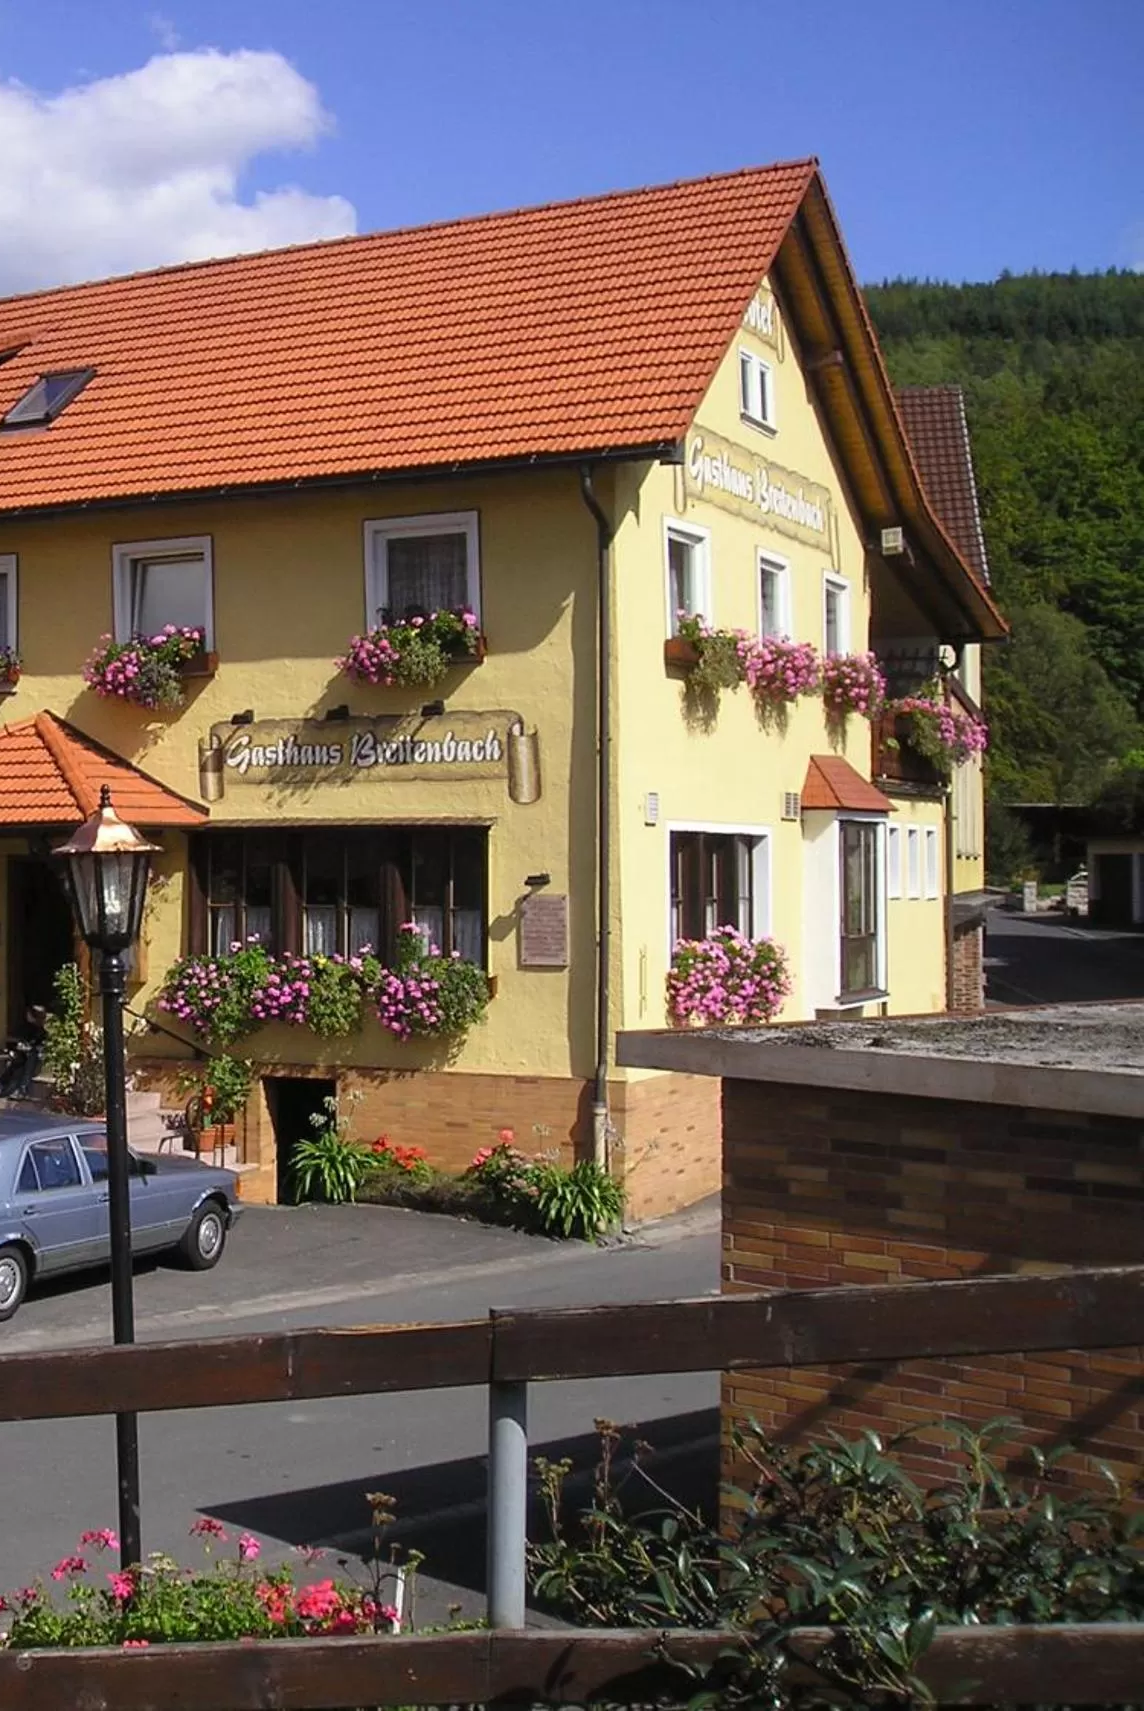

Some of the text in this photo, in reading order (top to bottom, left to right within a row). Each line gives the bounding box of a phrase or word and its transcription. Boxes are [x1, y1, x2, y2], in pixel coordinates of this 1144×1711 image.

[689, 435, 754, 504] Gasthaus
[226, 729, 502, 775] Gasthaus Breitenbach
